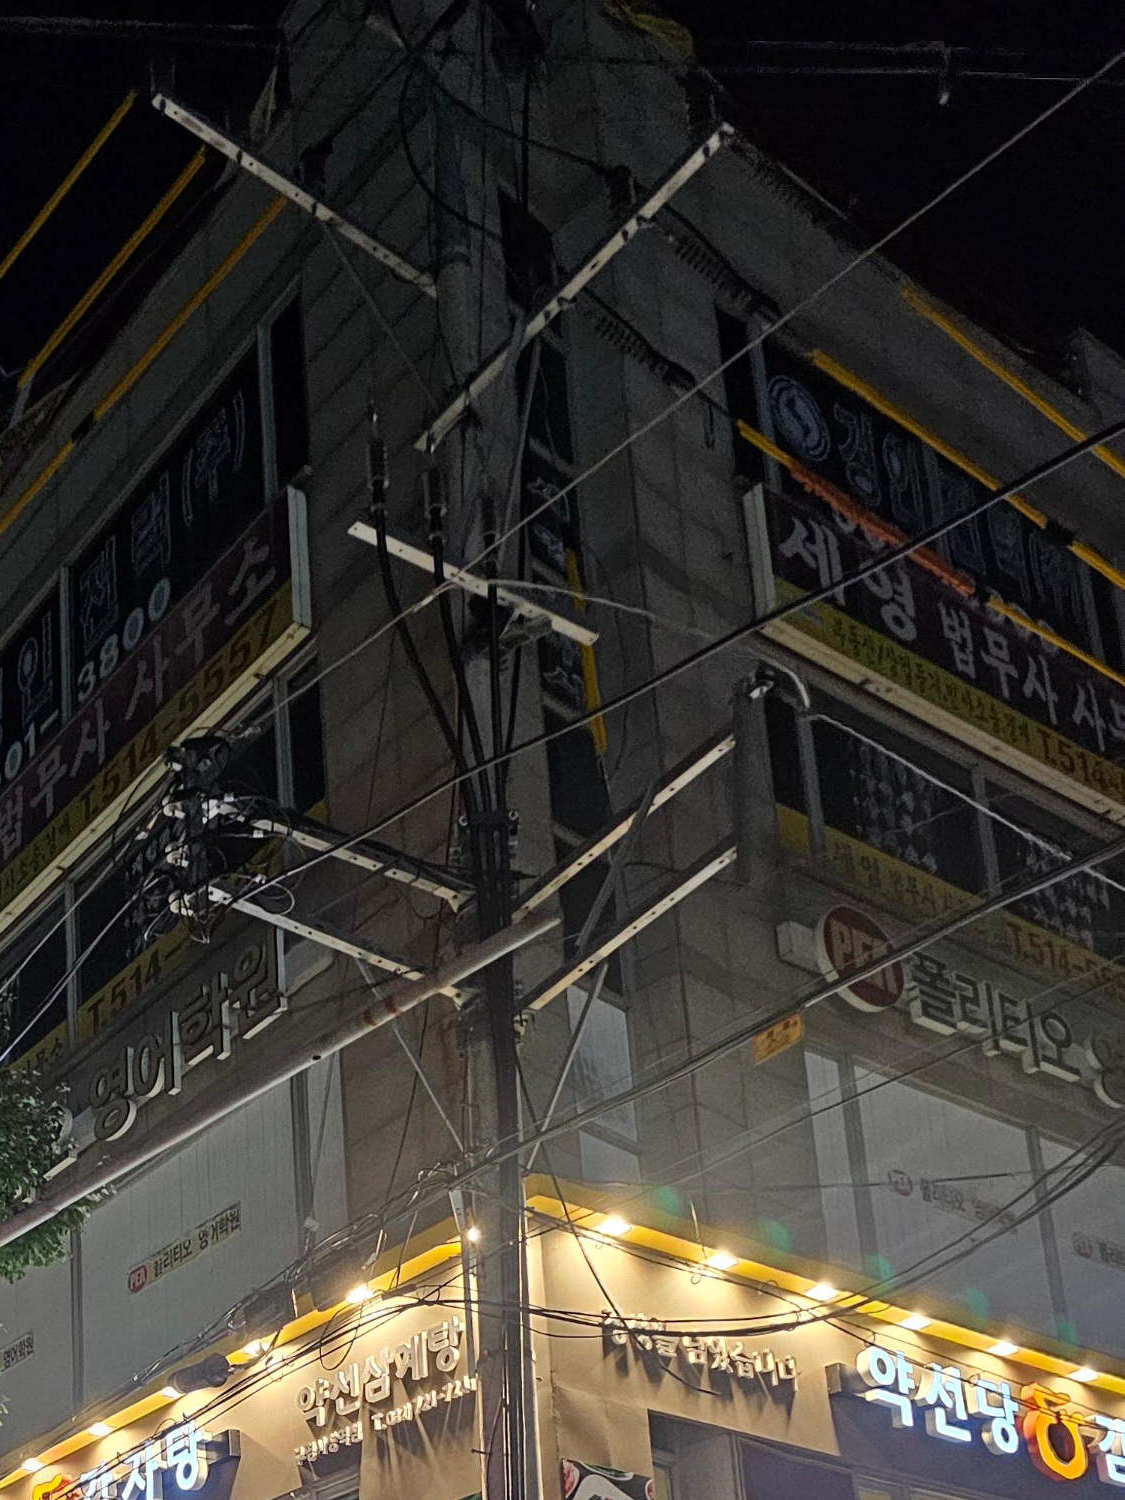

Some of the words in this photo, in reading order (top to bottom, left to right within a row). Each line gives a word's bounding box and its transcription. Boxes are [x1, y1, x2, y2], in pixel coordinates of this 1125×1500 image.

[125, 532, 275, 724] 사무소
[939, 600, 1058, 724] 법무사
[87, 922, 287, 1141] 영어학원
[911, 949, 1081, 1078] 폴리티오
[296, 1315, 467, 1427] 약선삼계탕
[681, 1335, 799, 1393] 담았습니다
[859, 1345, 1020, 1456] 약선당
